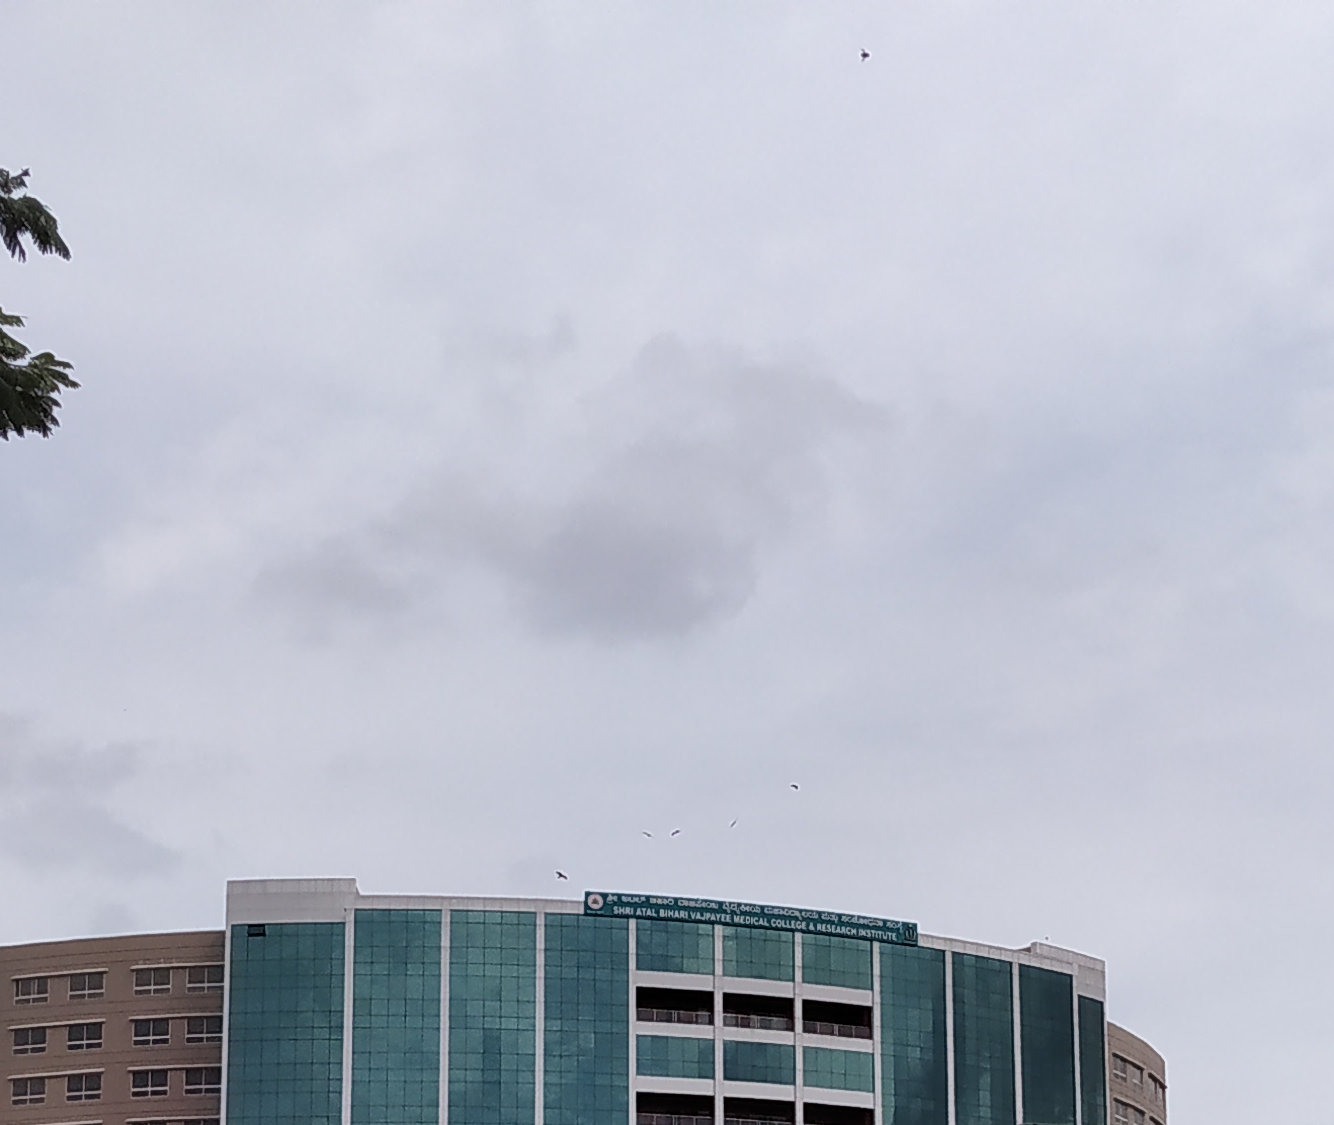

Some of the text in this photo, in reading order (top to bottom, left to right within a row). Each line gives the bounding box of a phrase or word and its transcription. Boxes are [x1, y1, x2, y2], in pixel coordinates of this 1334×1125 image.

[613, 906, 897, 941] SHRI ATAL BIHARI VAJPAYEE MEDICAL COLLEGE & RESEARCH INSTITUTE
